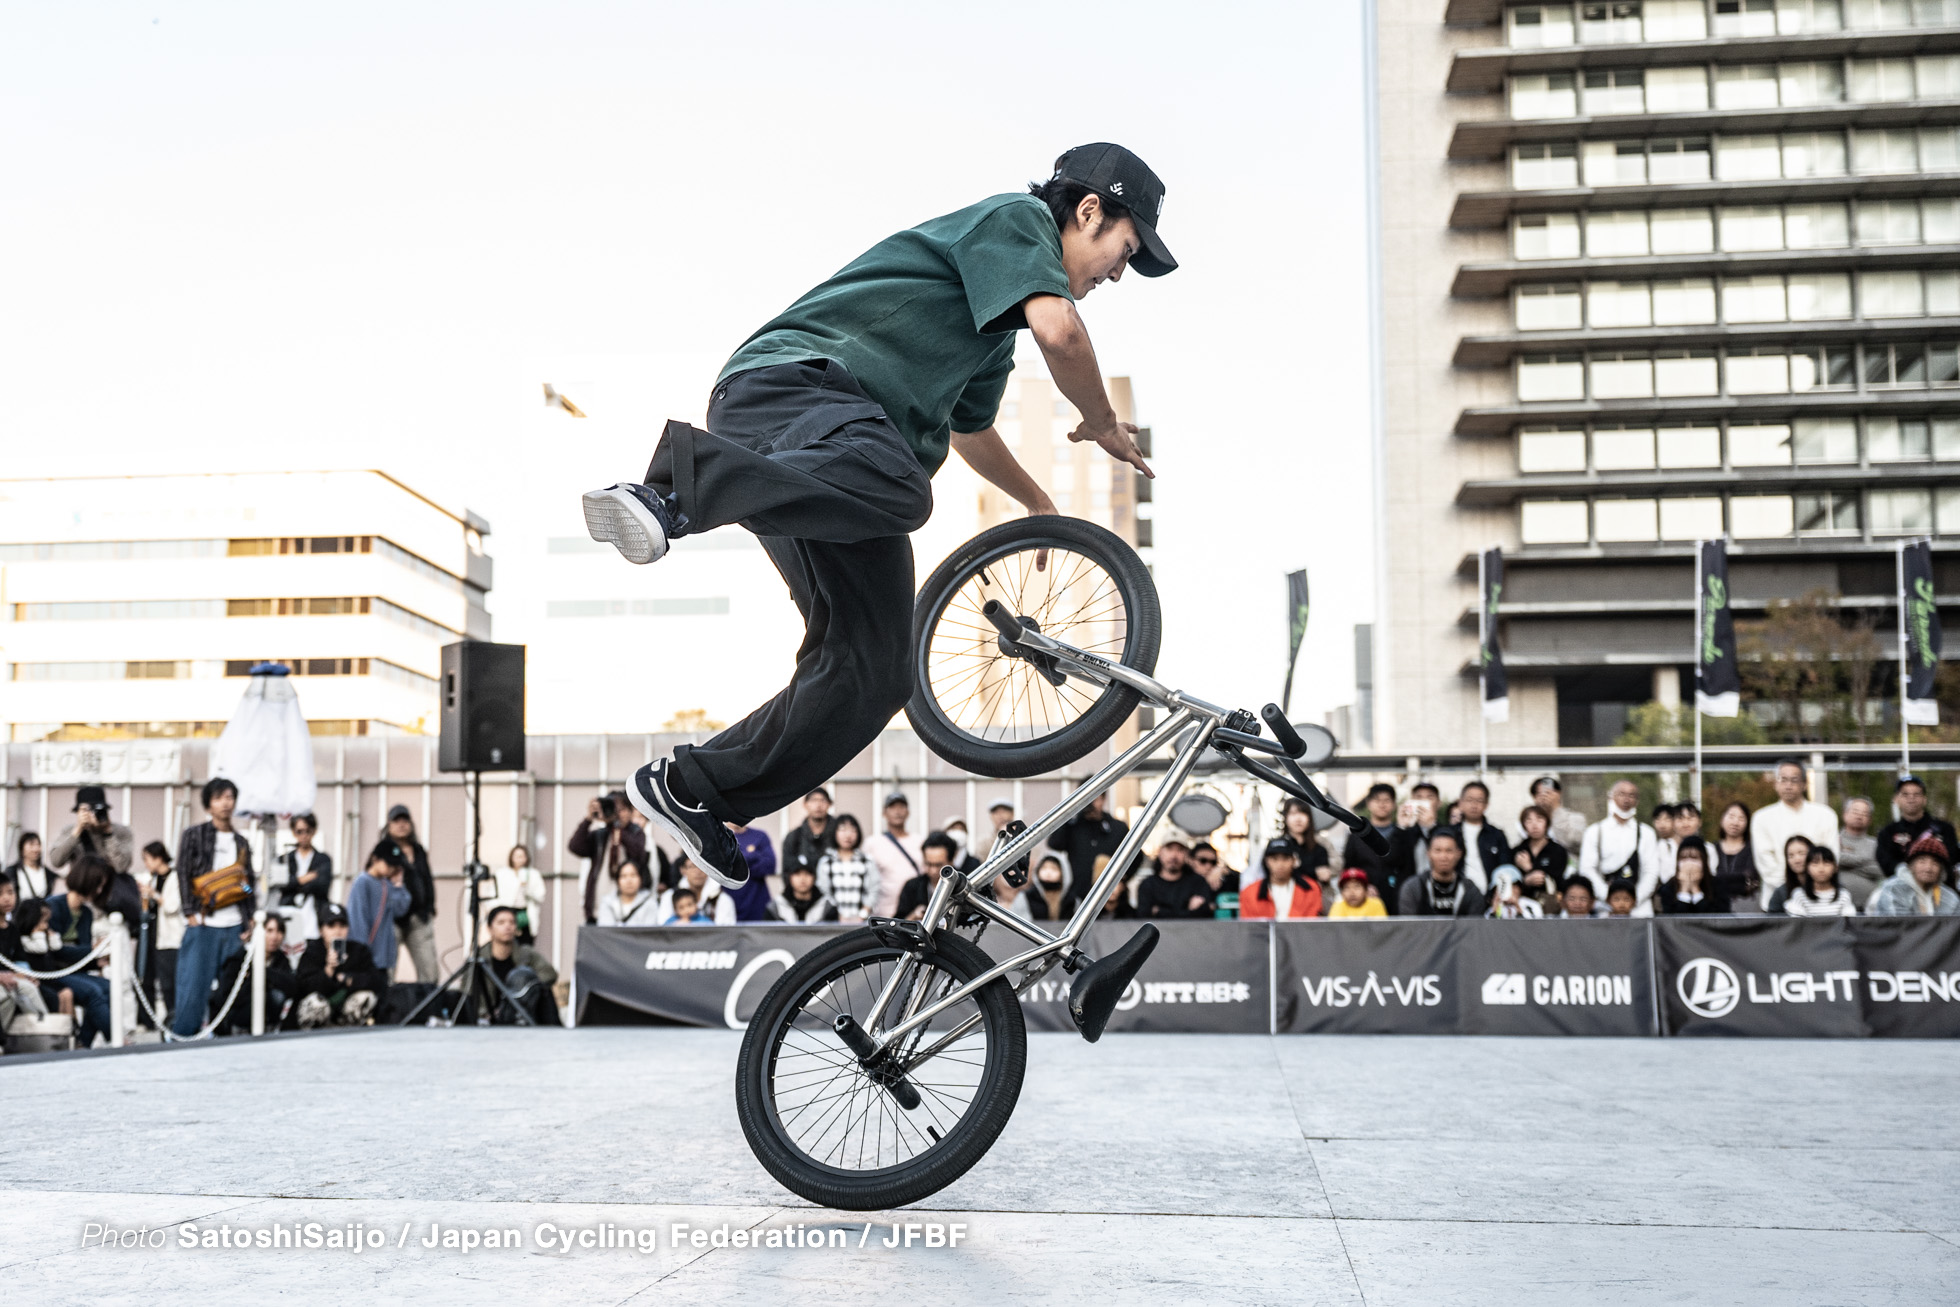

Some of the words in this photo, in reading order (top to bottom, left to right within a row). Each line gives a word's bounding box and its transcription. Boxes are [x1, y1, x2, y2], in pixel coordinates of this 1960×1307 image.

[645, 950, 738, 970] KEIRIN
[1532, 975, 1632, 1006] CARION
[1746, 971, 1860, 1003] LIGHT
